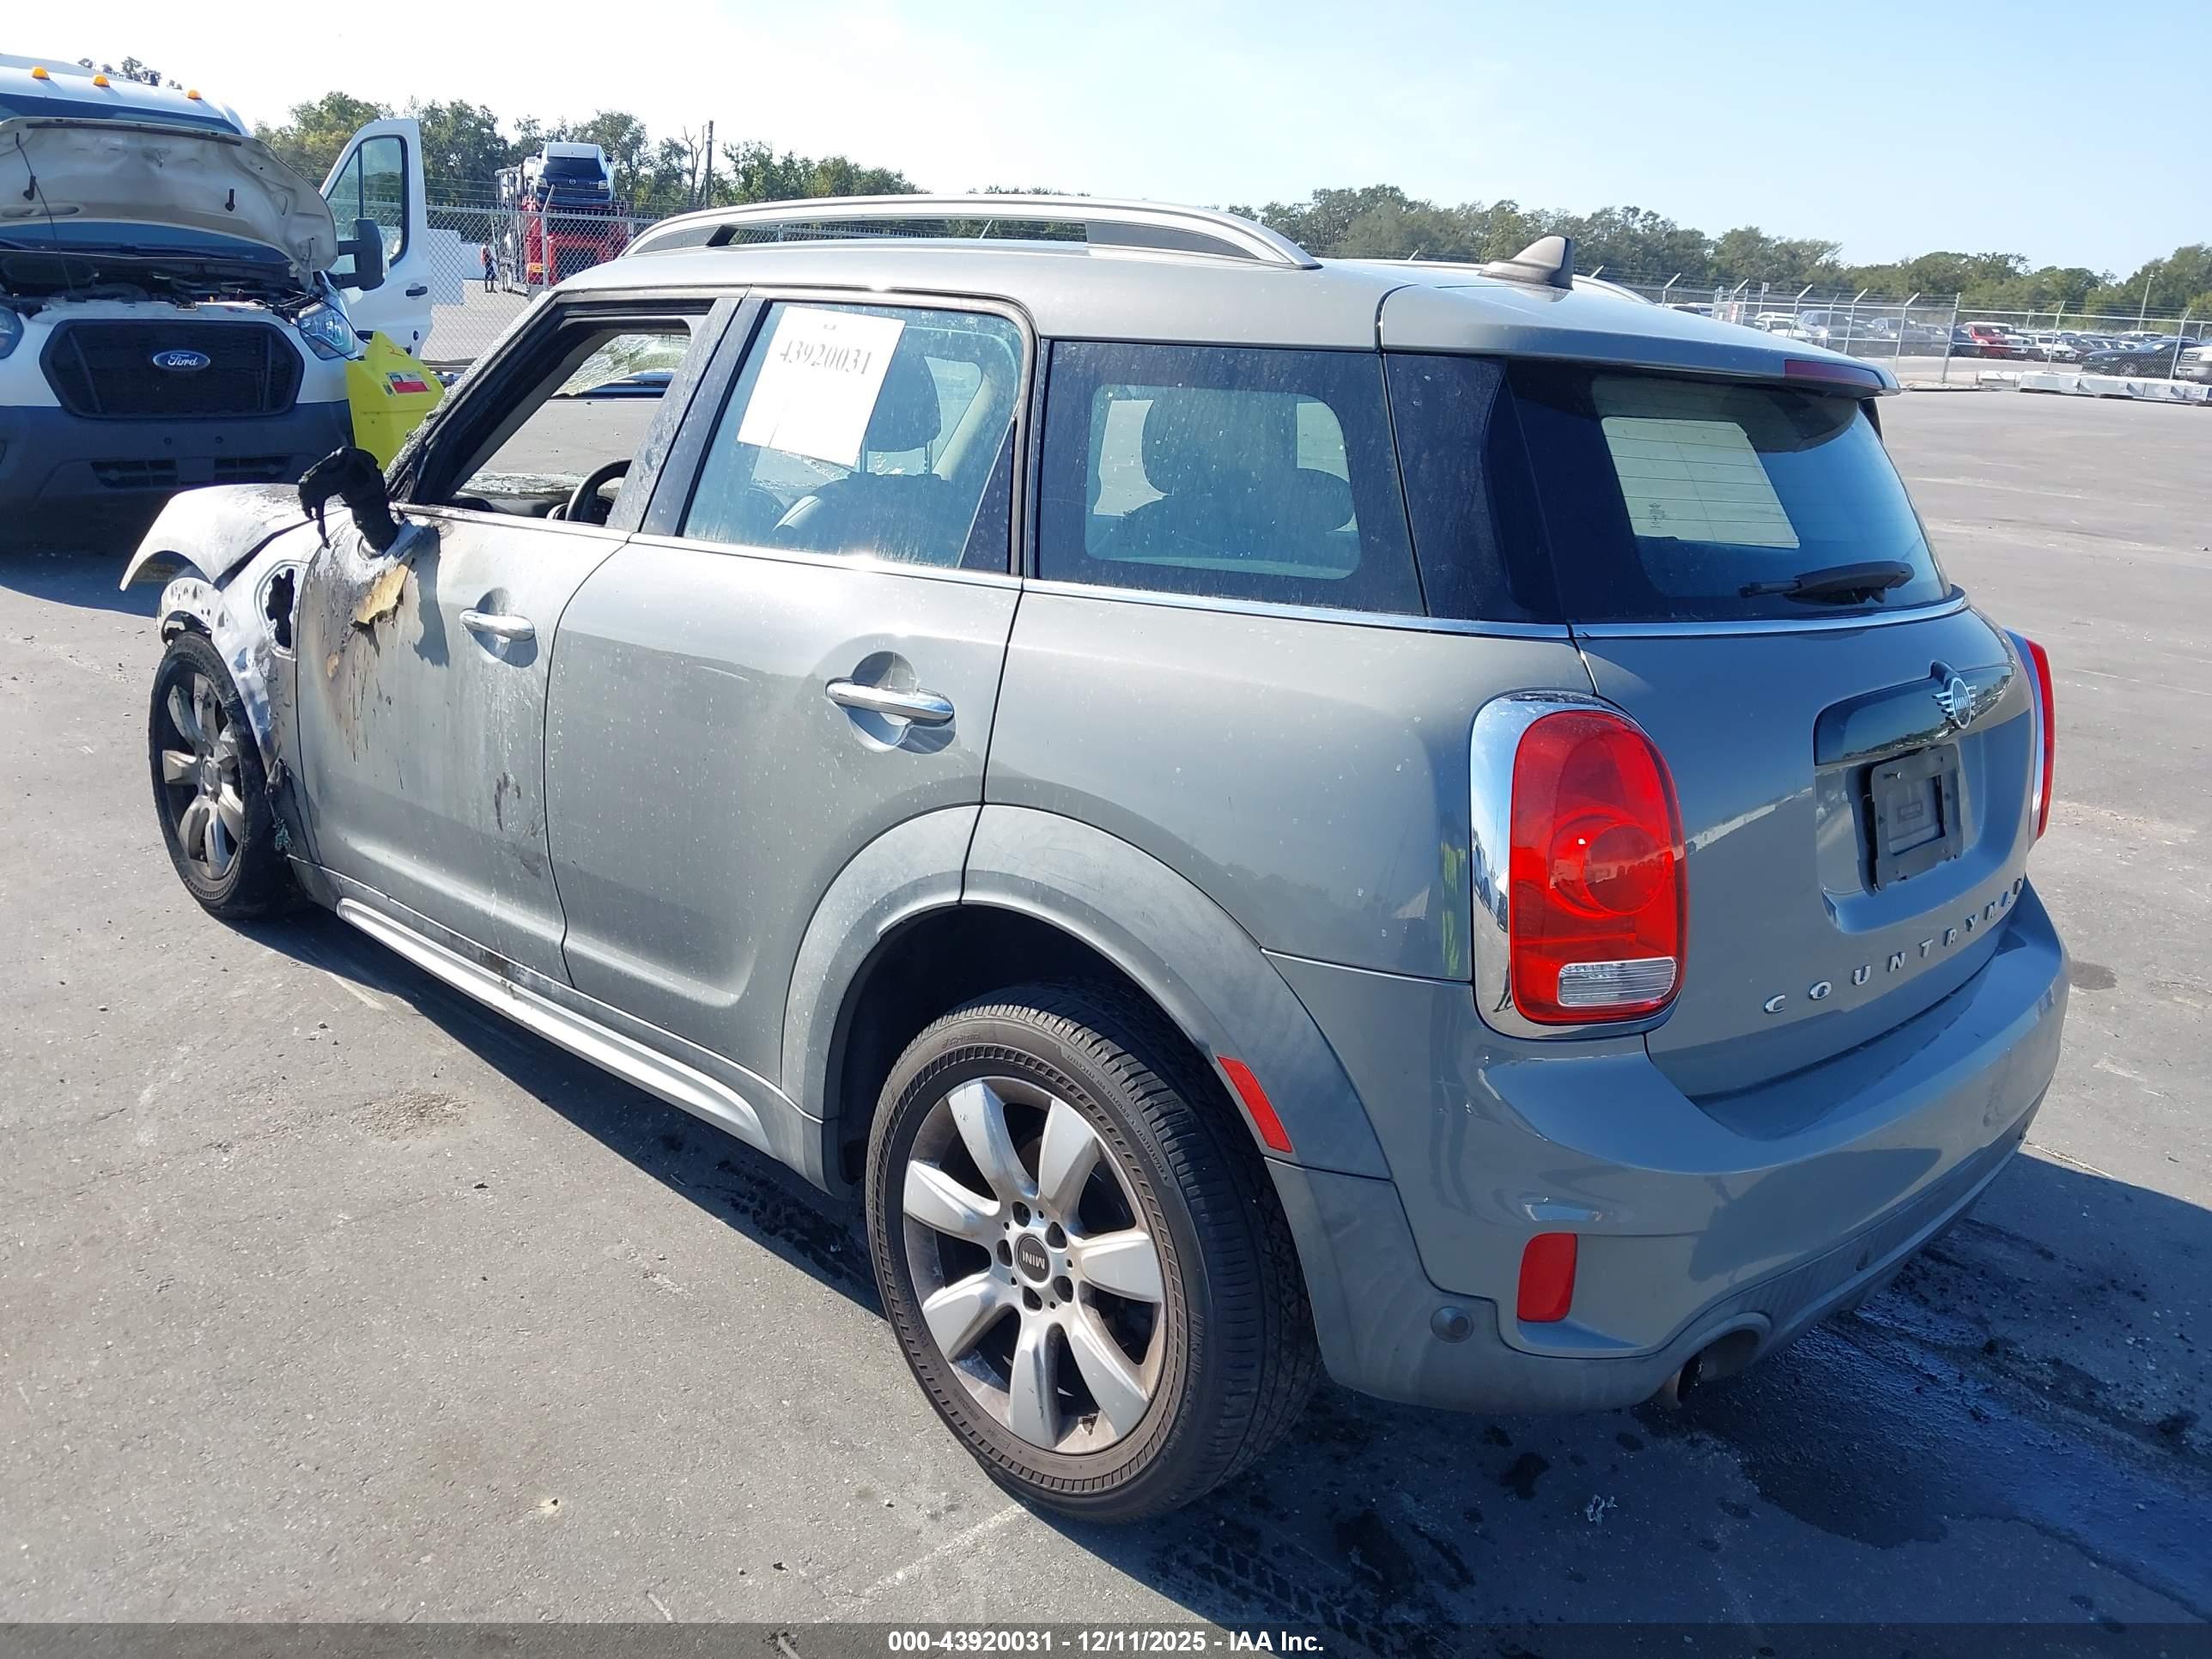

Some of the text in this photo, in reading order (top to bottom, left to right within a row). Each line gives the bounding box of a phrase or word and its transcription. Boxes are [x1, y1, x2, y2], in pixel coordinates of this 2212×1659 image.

[167, 353, 198, 367] Ford
[779, 340, 872, 374] 43920031
[1954, 695, 1969, 711] MINI
[1022, 1249, 1046, 1271] MINI
